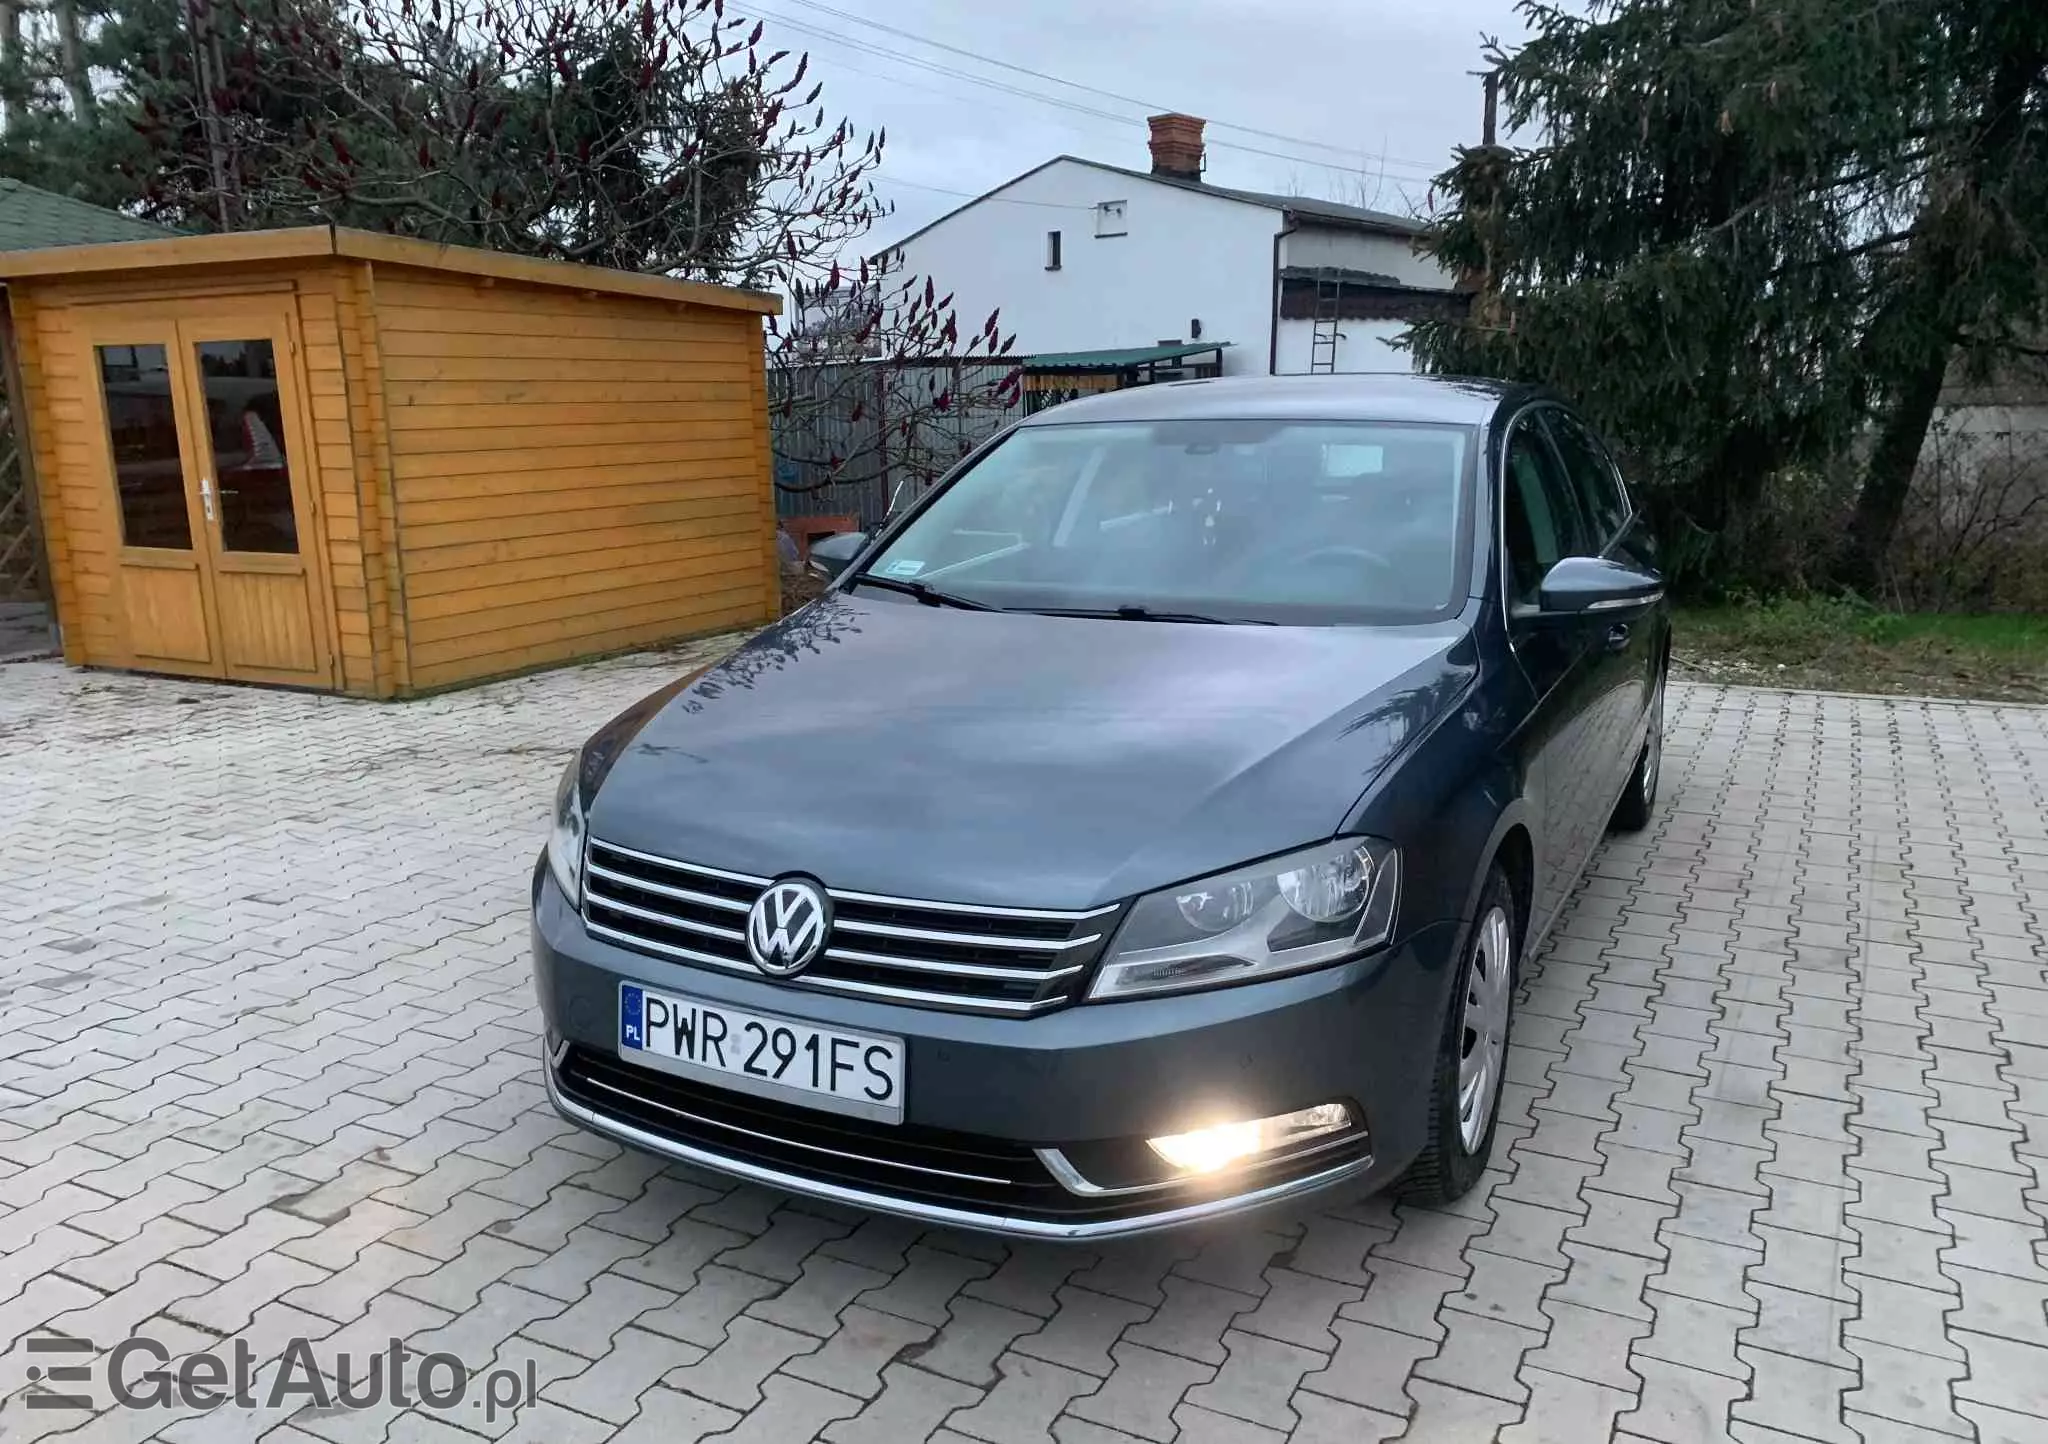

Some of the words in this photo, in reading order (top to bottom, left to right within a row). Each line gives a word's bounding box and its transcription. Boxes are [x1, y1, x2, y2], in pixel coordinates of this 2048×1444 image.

[625, 1024, 641, 1041] PL
[646, 997, 728, 1067] PWR
[743, 1021, 894, 1101] 291FS
